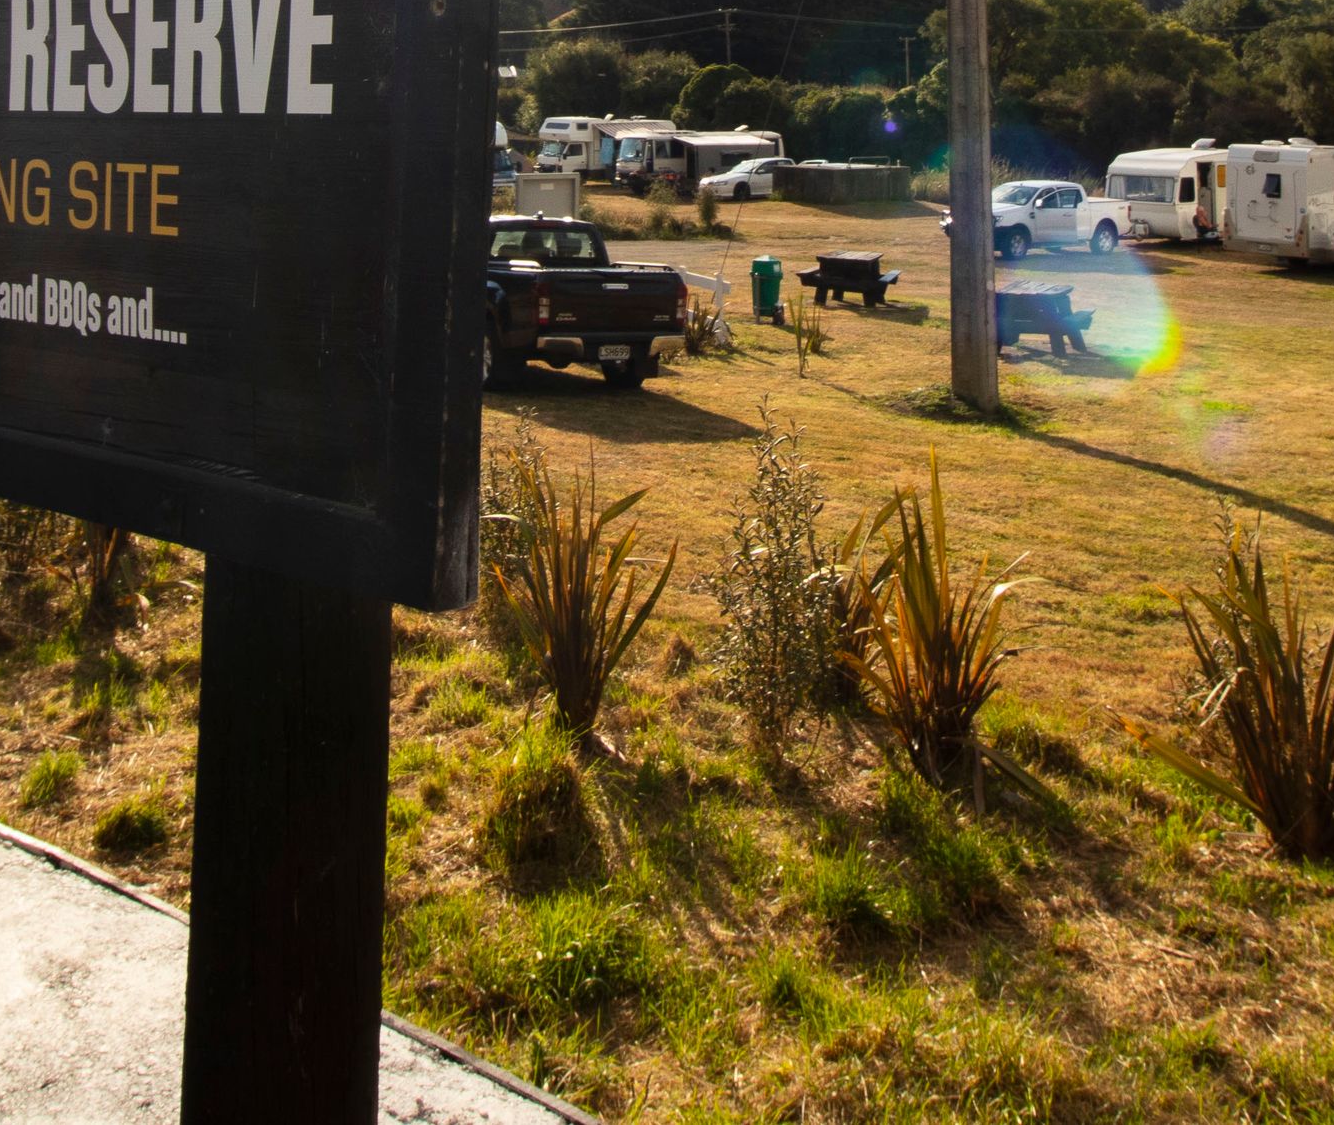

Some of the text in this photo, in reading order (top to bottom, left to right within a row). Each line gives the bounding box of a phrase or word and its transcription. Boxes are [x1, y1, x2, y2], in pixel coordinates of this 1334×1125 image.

[68, 160, 180, 236] SITE
[44, 277, 102, 336] BBQs
[107, 286, 188, 345] and....
